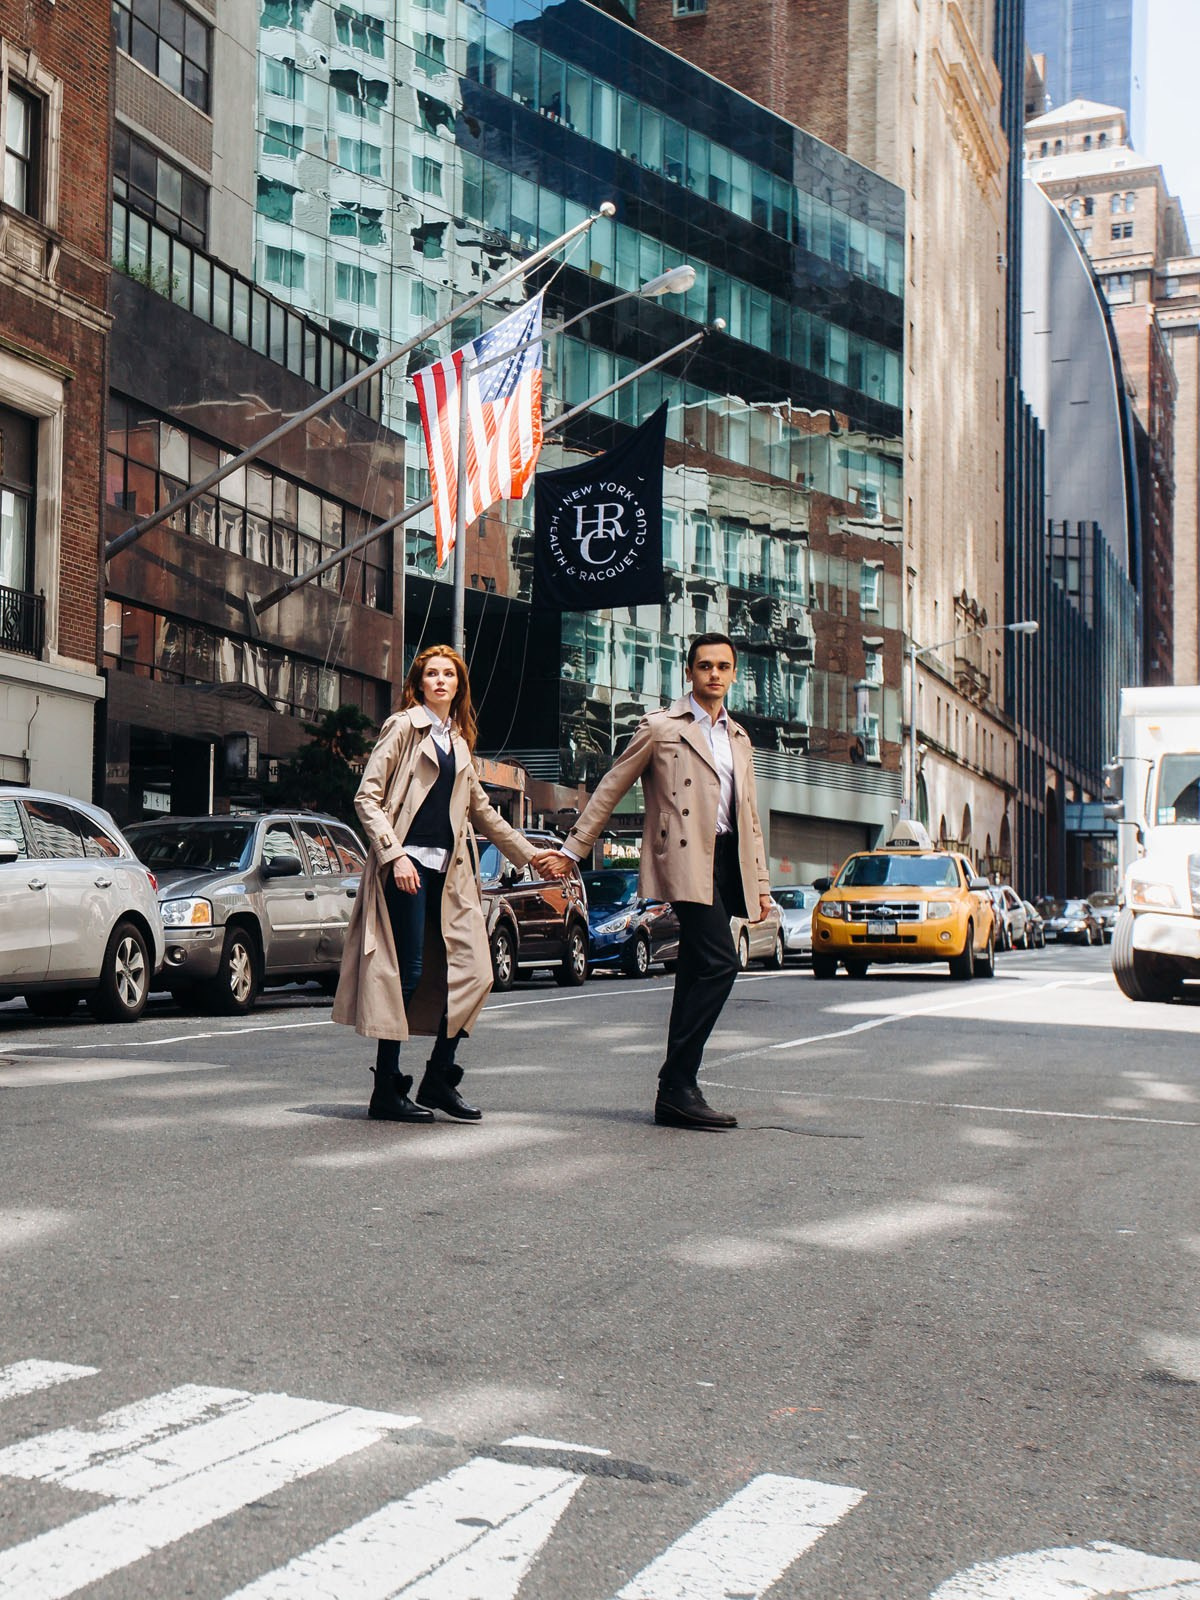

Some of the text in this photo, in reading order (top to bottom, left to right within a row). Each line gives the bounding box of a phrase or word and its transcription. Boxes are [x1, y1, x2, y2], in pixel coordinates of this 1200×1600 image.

[562, 482, 635, 506] NEW YORK
[550, 507, 647, 582] HEALTH & RACQUET CLUB
